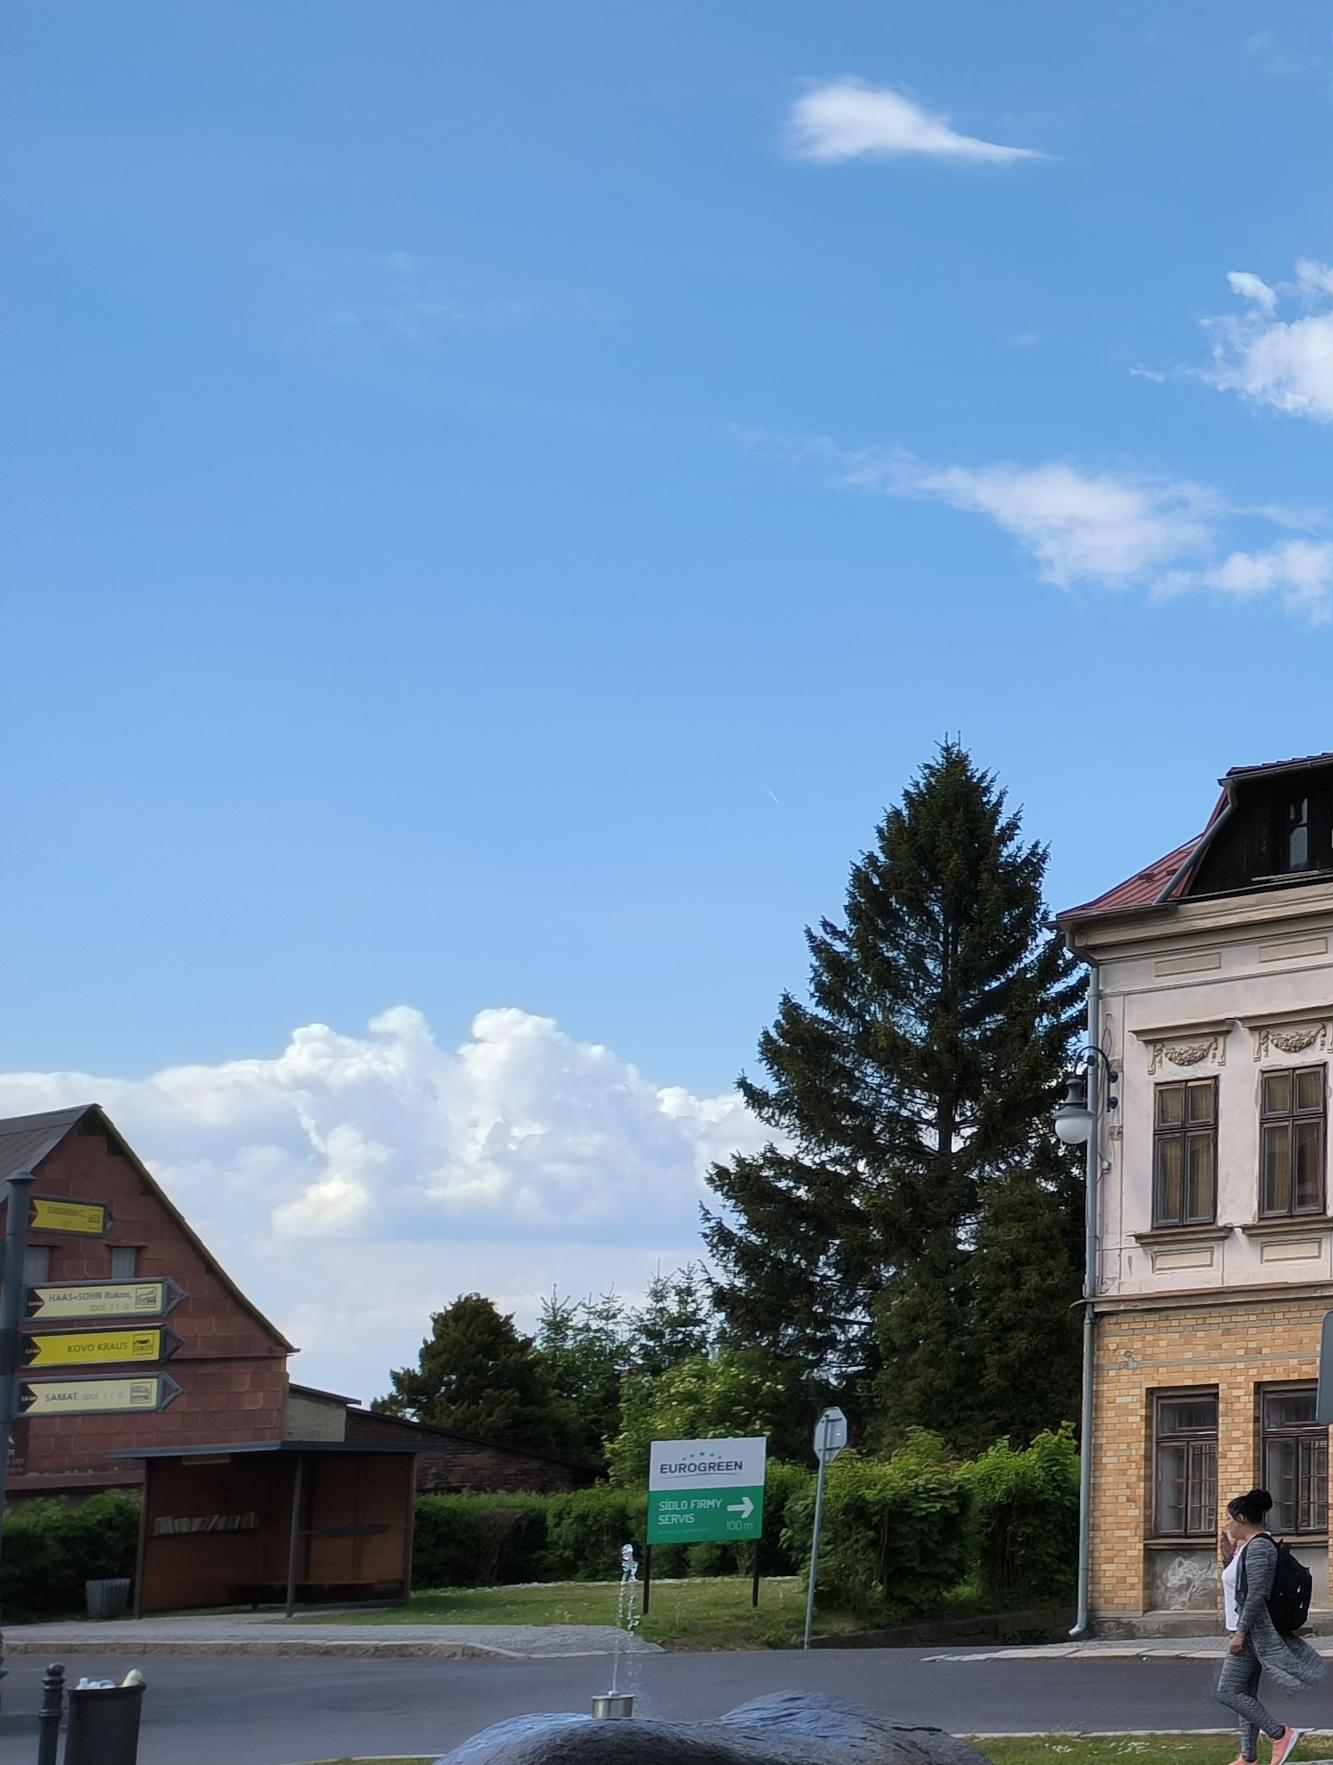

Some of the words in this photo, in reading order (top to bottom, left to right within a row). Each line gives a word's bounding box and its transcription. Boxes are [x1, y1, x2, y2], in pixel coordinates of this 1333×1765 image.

[67, 1343, 95, 1353] KOVO
[97, 1341, 128, 1351] KRAUS
[660, 1460, 743, 1474] EUROGREEN
[658, 1498, 688, 1511] SÍDLO
[690, 1499, 722, 1510] FIRMY
[658, 1512, 695, 1525] SERVIS
[726, 1519, 742, 1531] 100
